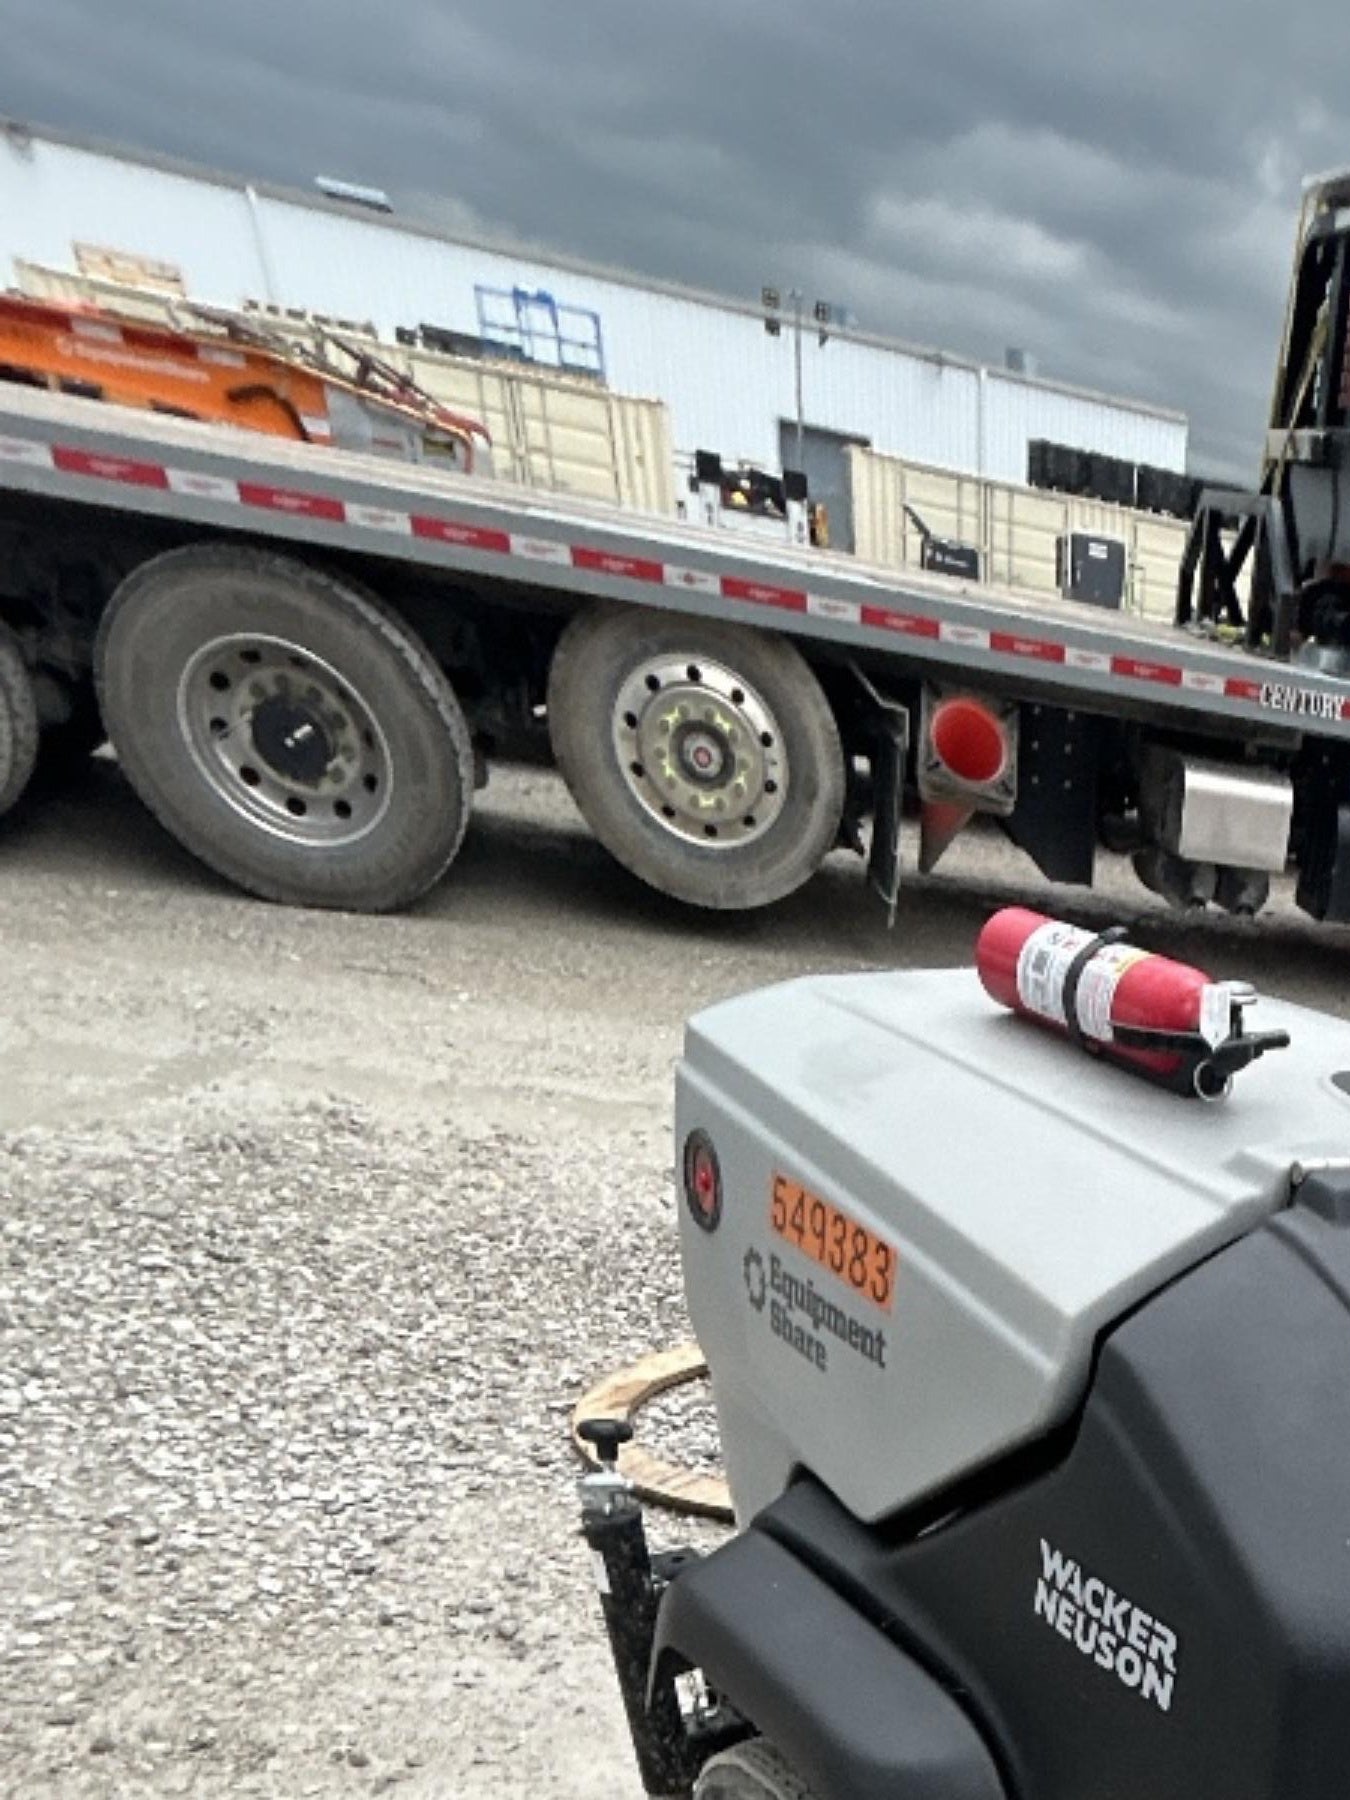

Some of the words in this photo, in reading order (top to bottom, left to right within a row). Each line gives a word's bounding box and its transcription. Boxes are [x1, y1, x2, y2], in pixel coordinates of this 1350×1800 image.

[1259, 680, 1345, 721] CENTURY
[771, 1174, 891, 1303] 549383
[769, 1252, 887, 1370] Equipment
[769, 1298, 828, 1372] Share
[1033, 1577, 1176, 1713] NEUSON
[1039, 1537, 1178, 1674] WACKER
